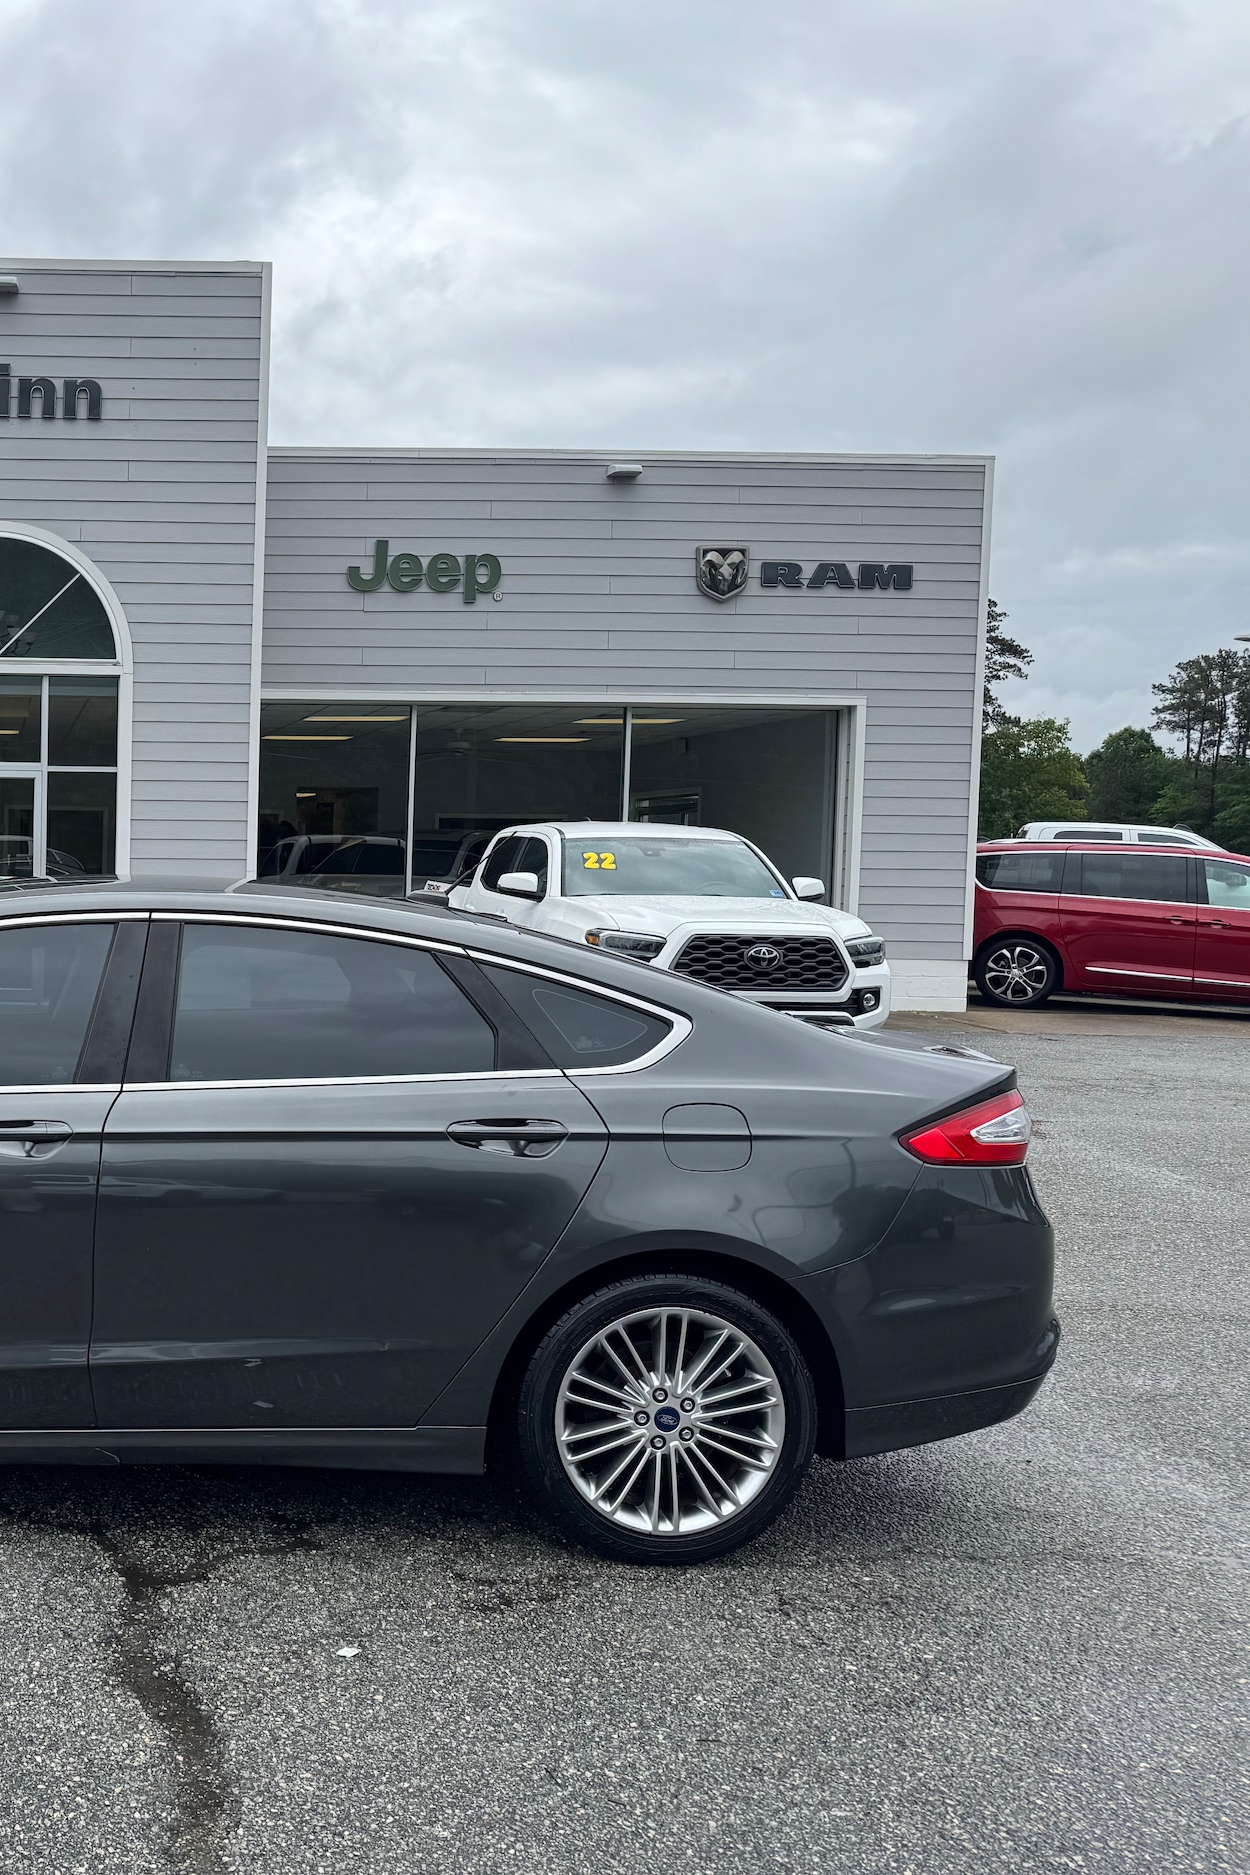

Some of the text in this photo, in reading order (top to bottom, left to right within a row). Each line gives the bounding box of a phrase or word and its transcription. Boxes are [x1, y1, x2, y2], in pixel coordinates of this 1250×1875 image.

[347, 539, 502, 603] Jeep
[760, 561, 914, 590] RAM
[582, 851, 618, 870] 22
